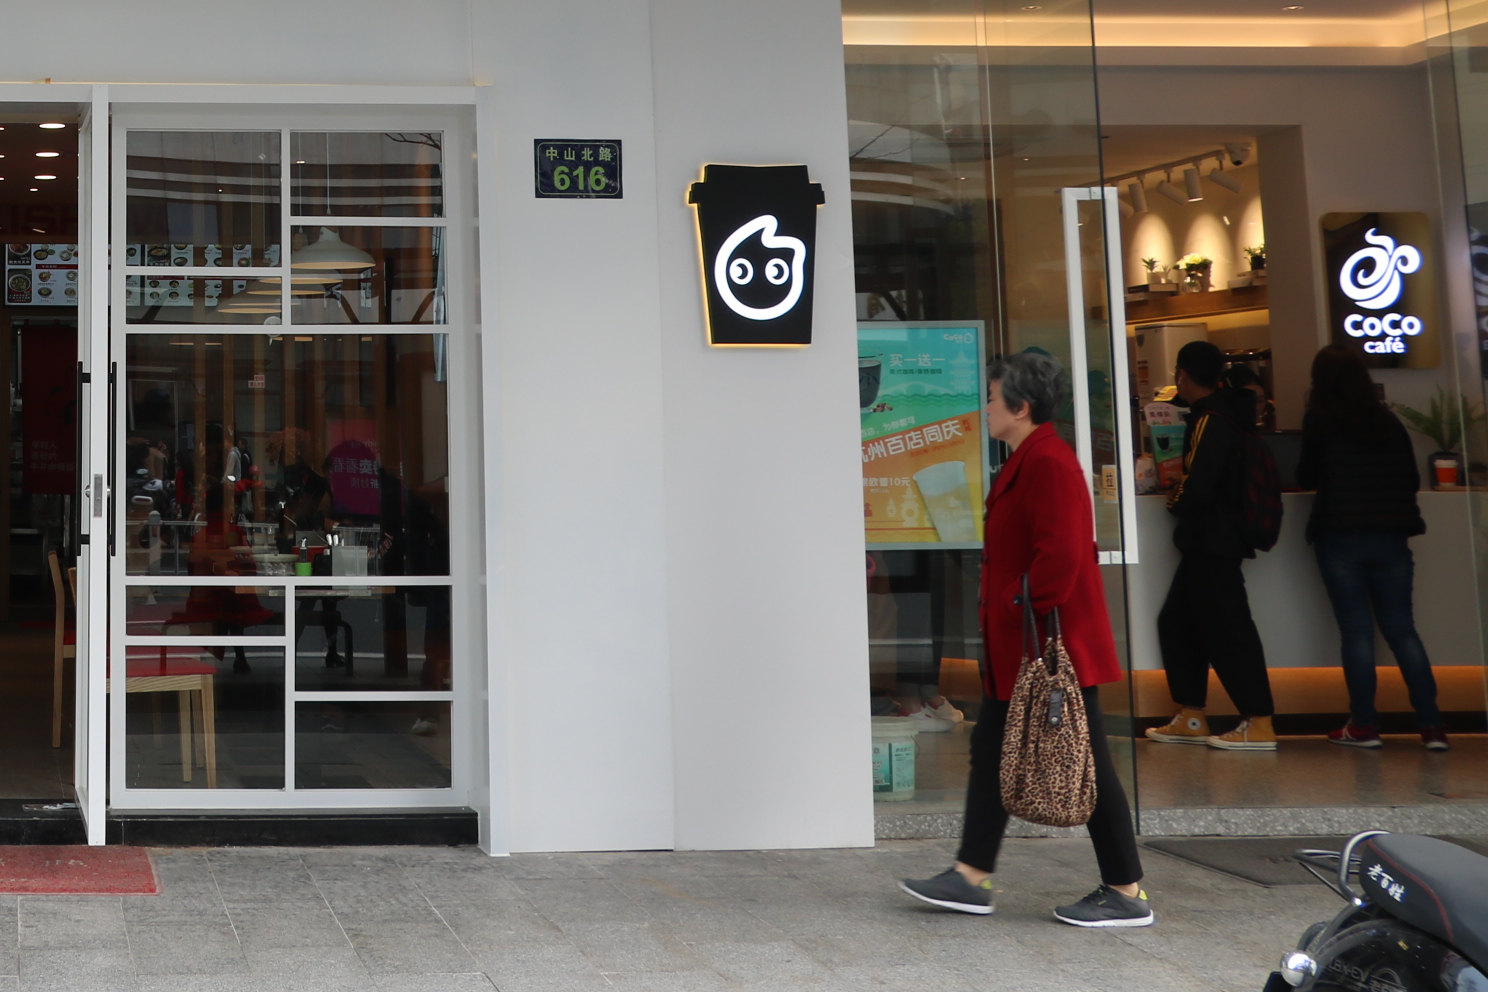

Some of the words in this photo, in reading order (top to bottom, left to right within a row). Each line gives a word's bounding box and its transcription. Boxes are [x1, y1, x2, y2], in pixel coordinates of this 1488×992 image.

[545, 146, 613, 162] 中山北路
[553, 165, 607, 191] 616
[1363, 337, 1406, 354] café
[889, 353, 946, 367] 买一送一
[1366, 863, 1405, 902] 老百姓
